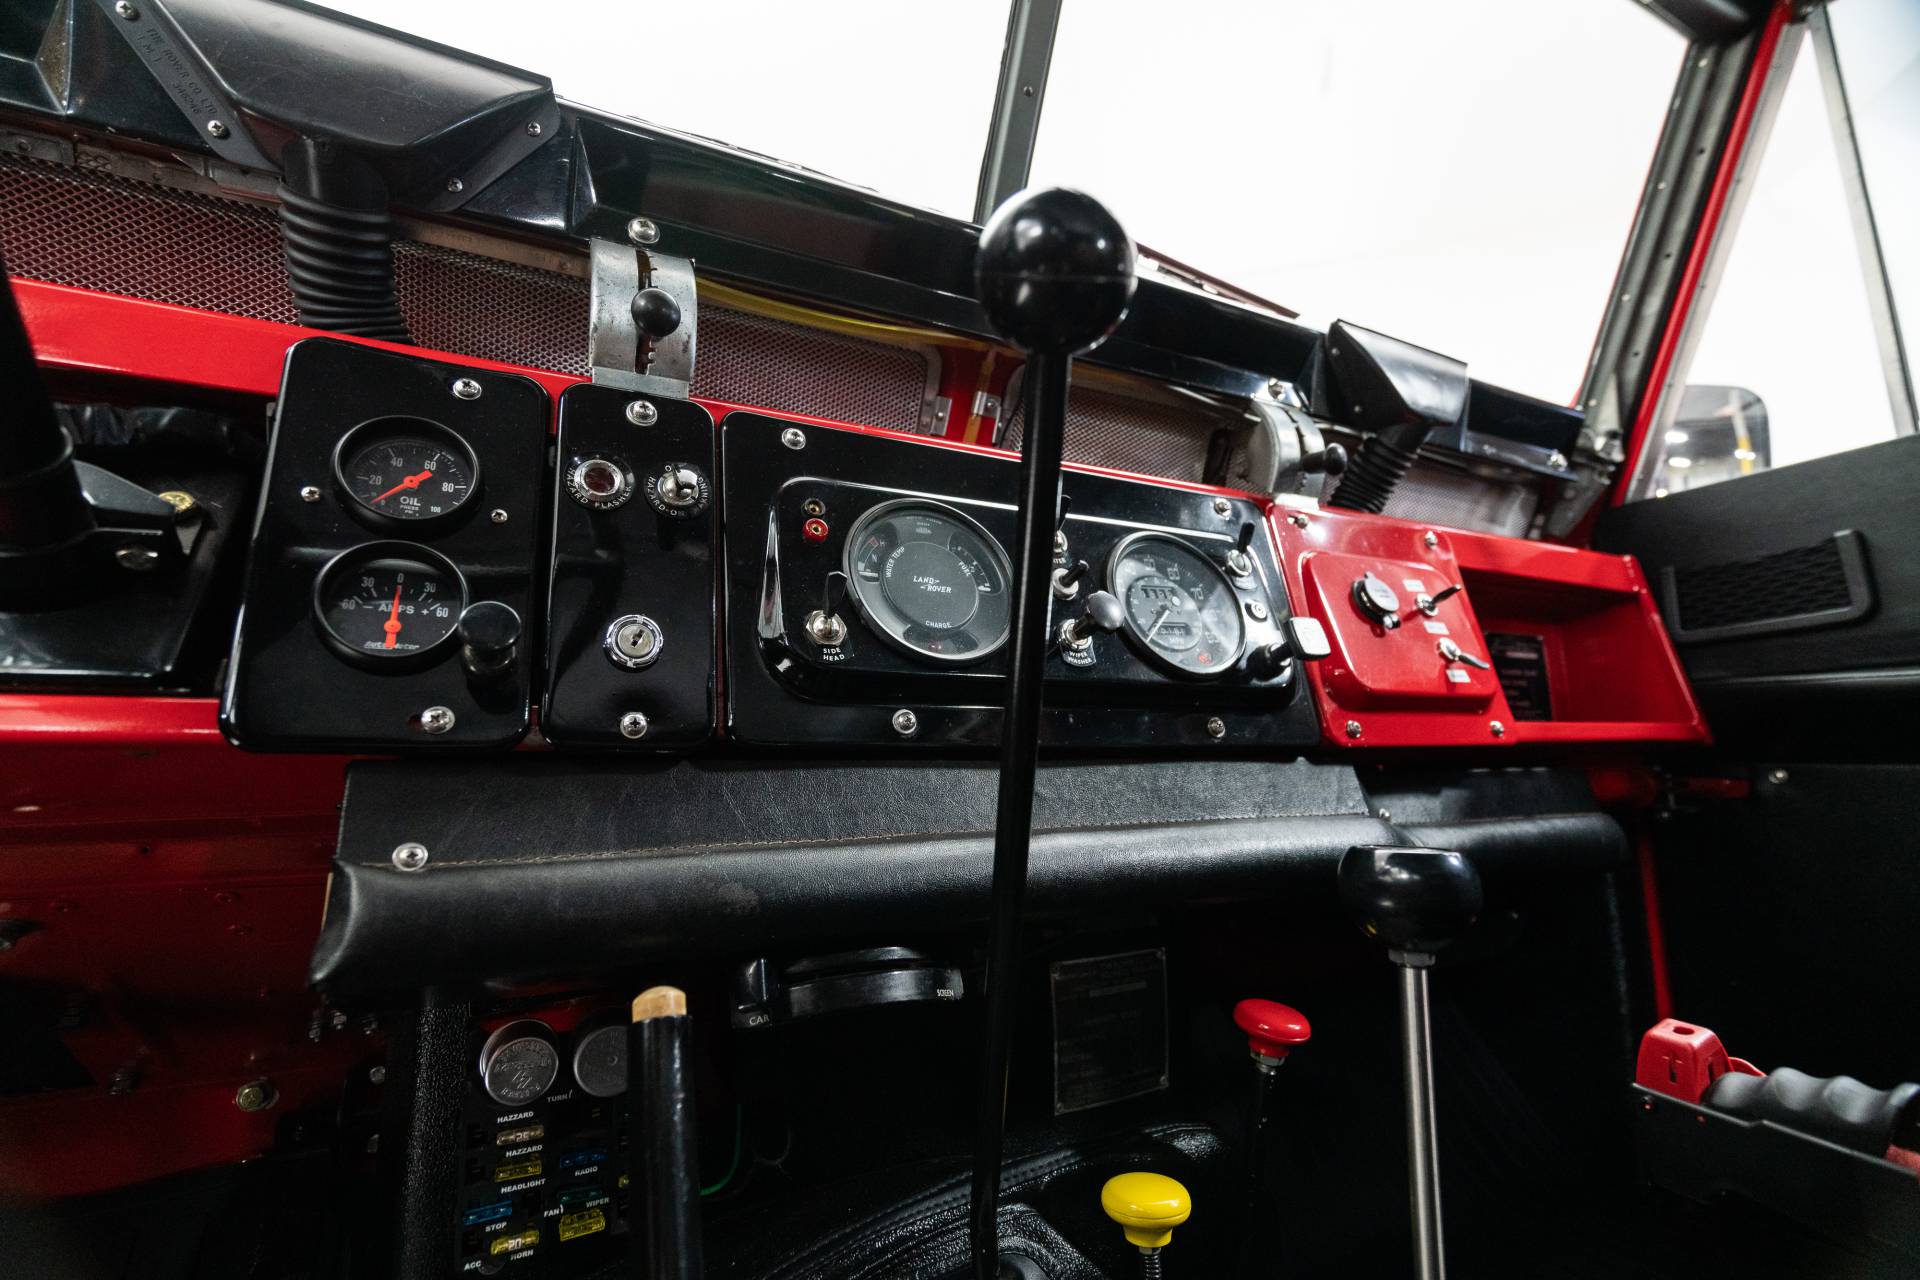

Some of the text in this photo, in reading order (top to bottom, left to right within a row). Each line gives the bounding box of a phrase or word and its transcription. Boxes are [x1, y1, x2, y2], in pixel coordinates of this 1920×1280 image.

[391, 457, 437, 471] 40 60
[369, 475, 454, 493] 20 80
[594, 486, 632, 510] FLASHER
[647, 476, 671, 511] HAZARD
[400, 496, 421, 506] OIL
[885, 546, 905, 578] WATER TEMP
[958, 560, 971, 577] FUEL
[397, 573, 404, 583] 0
[913, 575, 934, 585] LAND
[361, 576, 436, 593] 30 30
[927, 585, 952, 594] ROVER
[342, 599, 448, 618] 60 60
[925, 619, 952, 629] CHARGE
[823, 653, 845, 662] HEAD
[1068, 656, 1092, 664] WASHER
[1069, 650, 1089, 658] WIPER
[748, 1014, 770, 1025] CAR
[497, 1111, 534, 1123] HAZZARD
[505, 1144, 543, 1158] HAZZARD
[574, 1166, 598, 1177] RADIO
[501, 1179, 546, 1194] HEADLIGHT
[586, 1197, 610, 1208] WIPER
[485, 1221, 507, 1233] STOP
[510, 1249, 534, 1261] HORN
[464, 1259, 482, 1271] ACC
